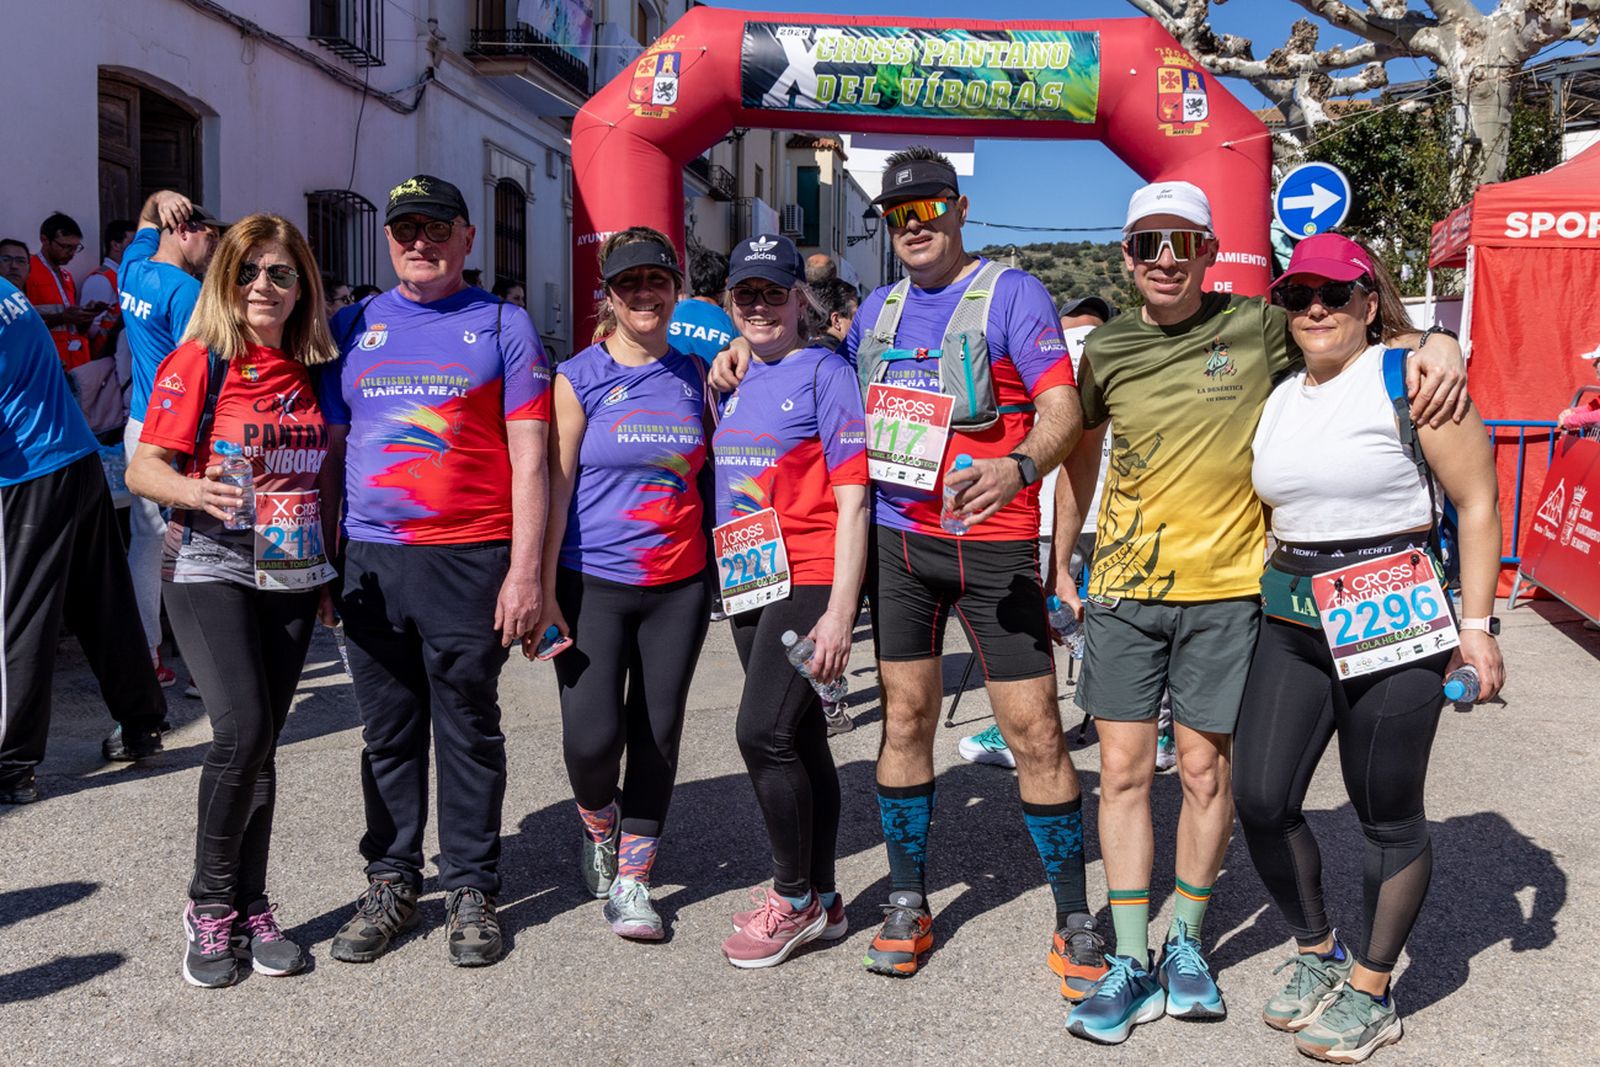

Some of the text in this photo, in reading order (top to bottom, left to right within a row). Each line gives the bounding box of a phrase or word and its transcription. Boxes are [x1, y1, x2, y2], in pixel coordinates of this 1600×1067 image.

[815, 36, 1072, 70] CROSS PANTANO
[762, 27, 843, 109] X
[815, 71, 1065, 111] DEL VÍBORAS
[744, 252, 777, 261] adidas
[1214, 281, 1233, 292] DE
[117, 287, 152, 320] TAFF
[669, 321, 731, 346] STAFF
[361, 376, 412, 388] ATLETISMO
[414, 375, 420, 384] Y
[362, 385, 468, 398] MANCHA REAL
[875, 390, 935, 416] X CROSS
[244, 423, 328, 449] PANTAN
[617, 424, 664, 433] ATLETISMO
[617, 434, 704, 446] MANCHA REAL
[873, 418, 928, 454] 117
[244, 445, 266, 457] DEL
[750, 457, 778, 468] REAL
[272, 498, 290, 516] X
[720, 523, 764, 548] X CROSS
[1357, 545, 1393, 556] TECHFIT
[721, 541, 777, 588] 2227
[1352, 564, 1413, 591] CROSS
[1290, 595, 1318, 617] LA
[1328, 585, 1439, 646] 2296
[1356, 638, 1382, 651] LOLA
